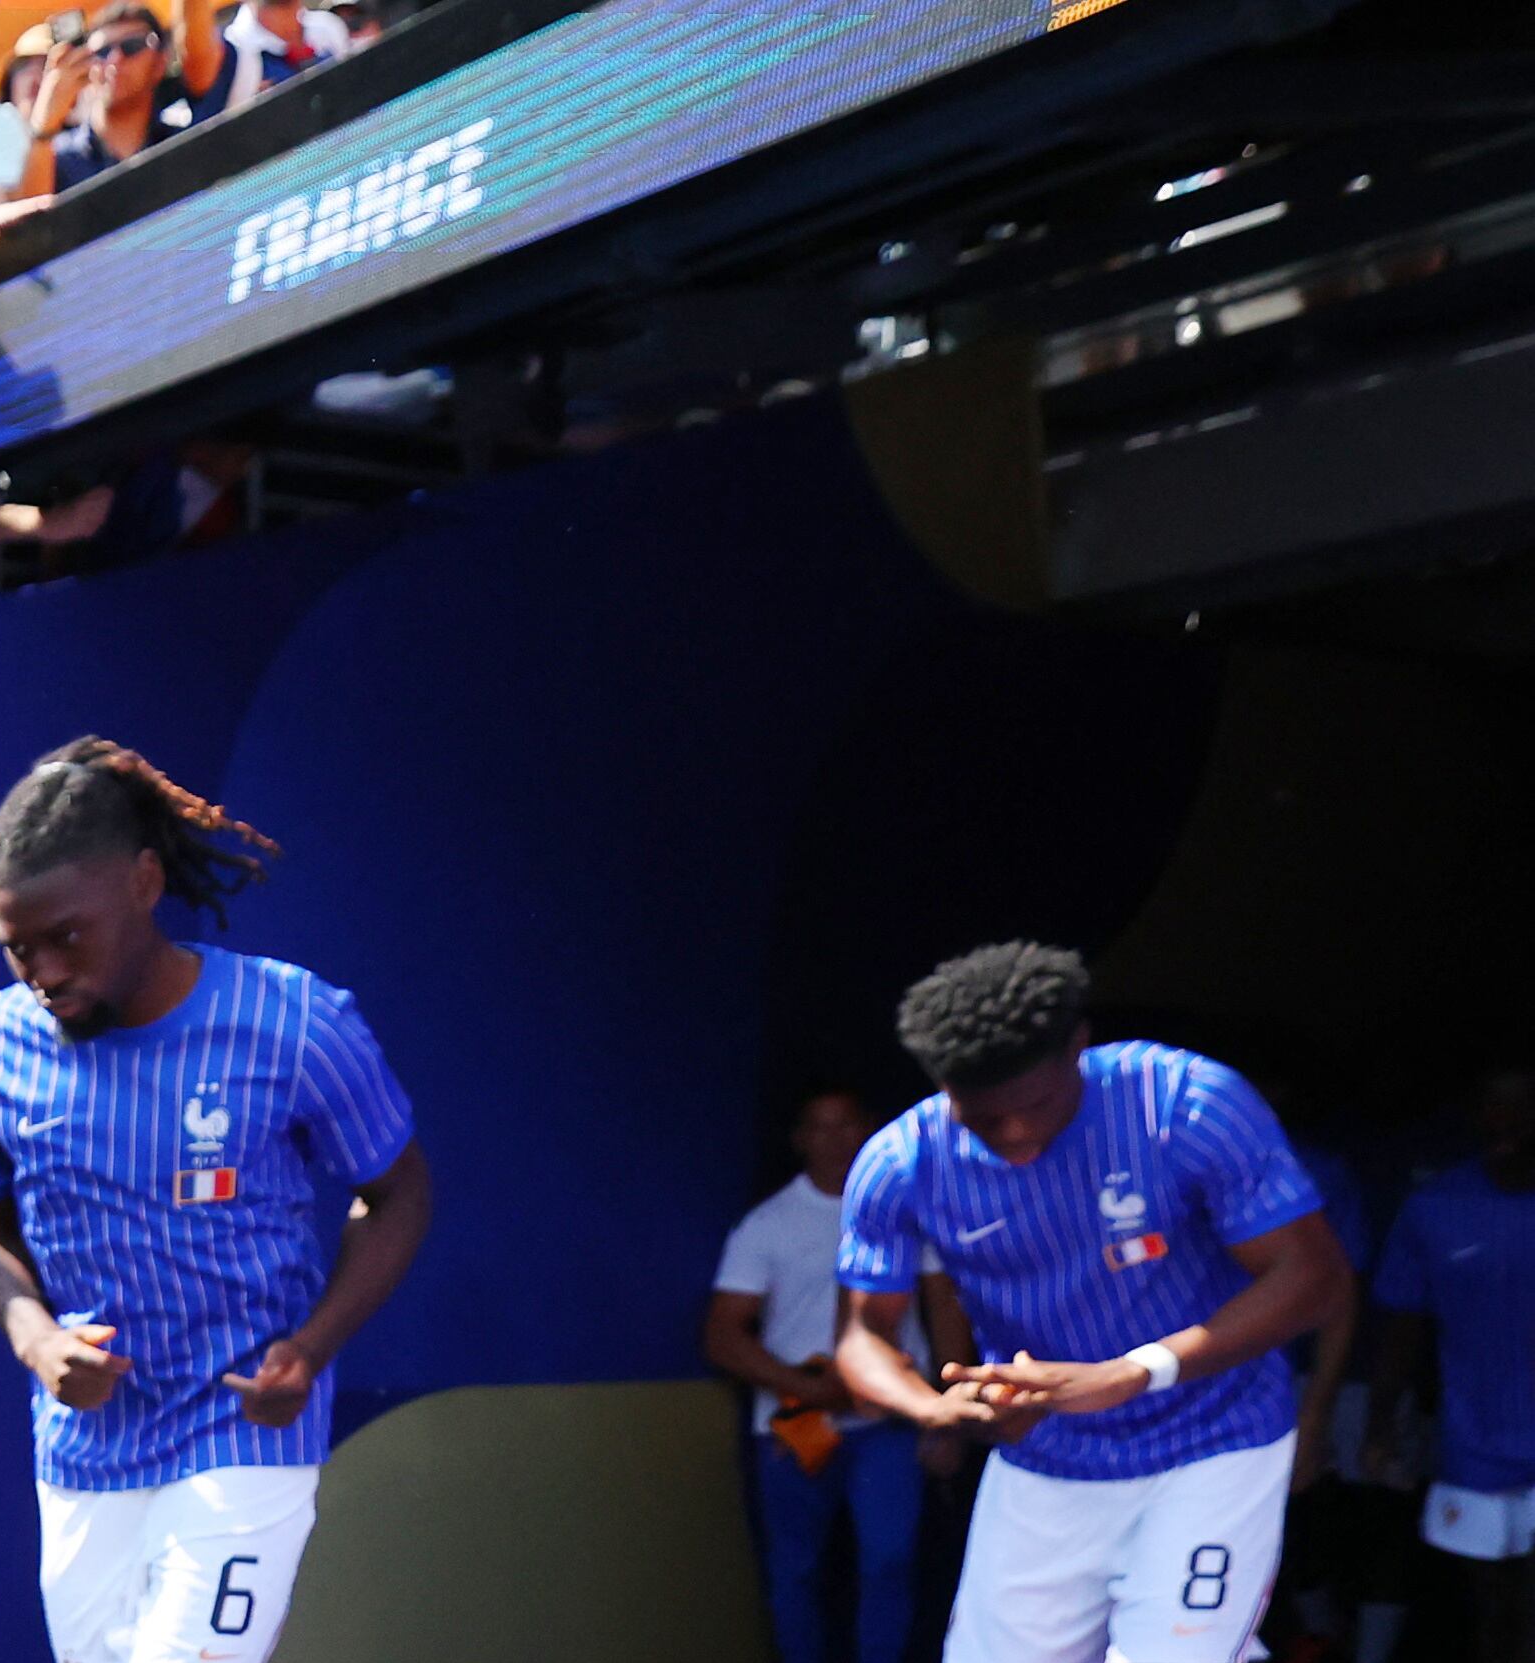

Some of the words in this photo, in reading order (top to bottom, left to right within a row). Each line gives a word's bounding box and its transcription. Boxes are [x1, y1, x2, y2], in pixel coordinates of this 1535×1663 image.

[227, 117, 494, 305] FRANCE
[209, 1554, 260, 1636] 6
[1181, 1543, 1232, 1611] 8
